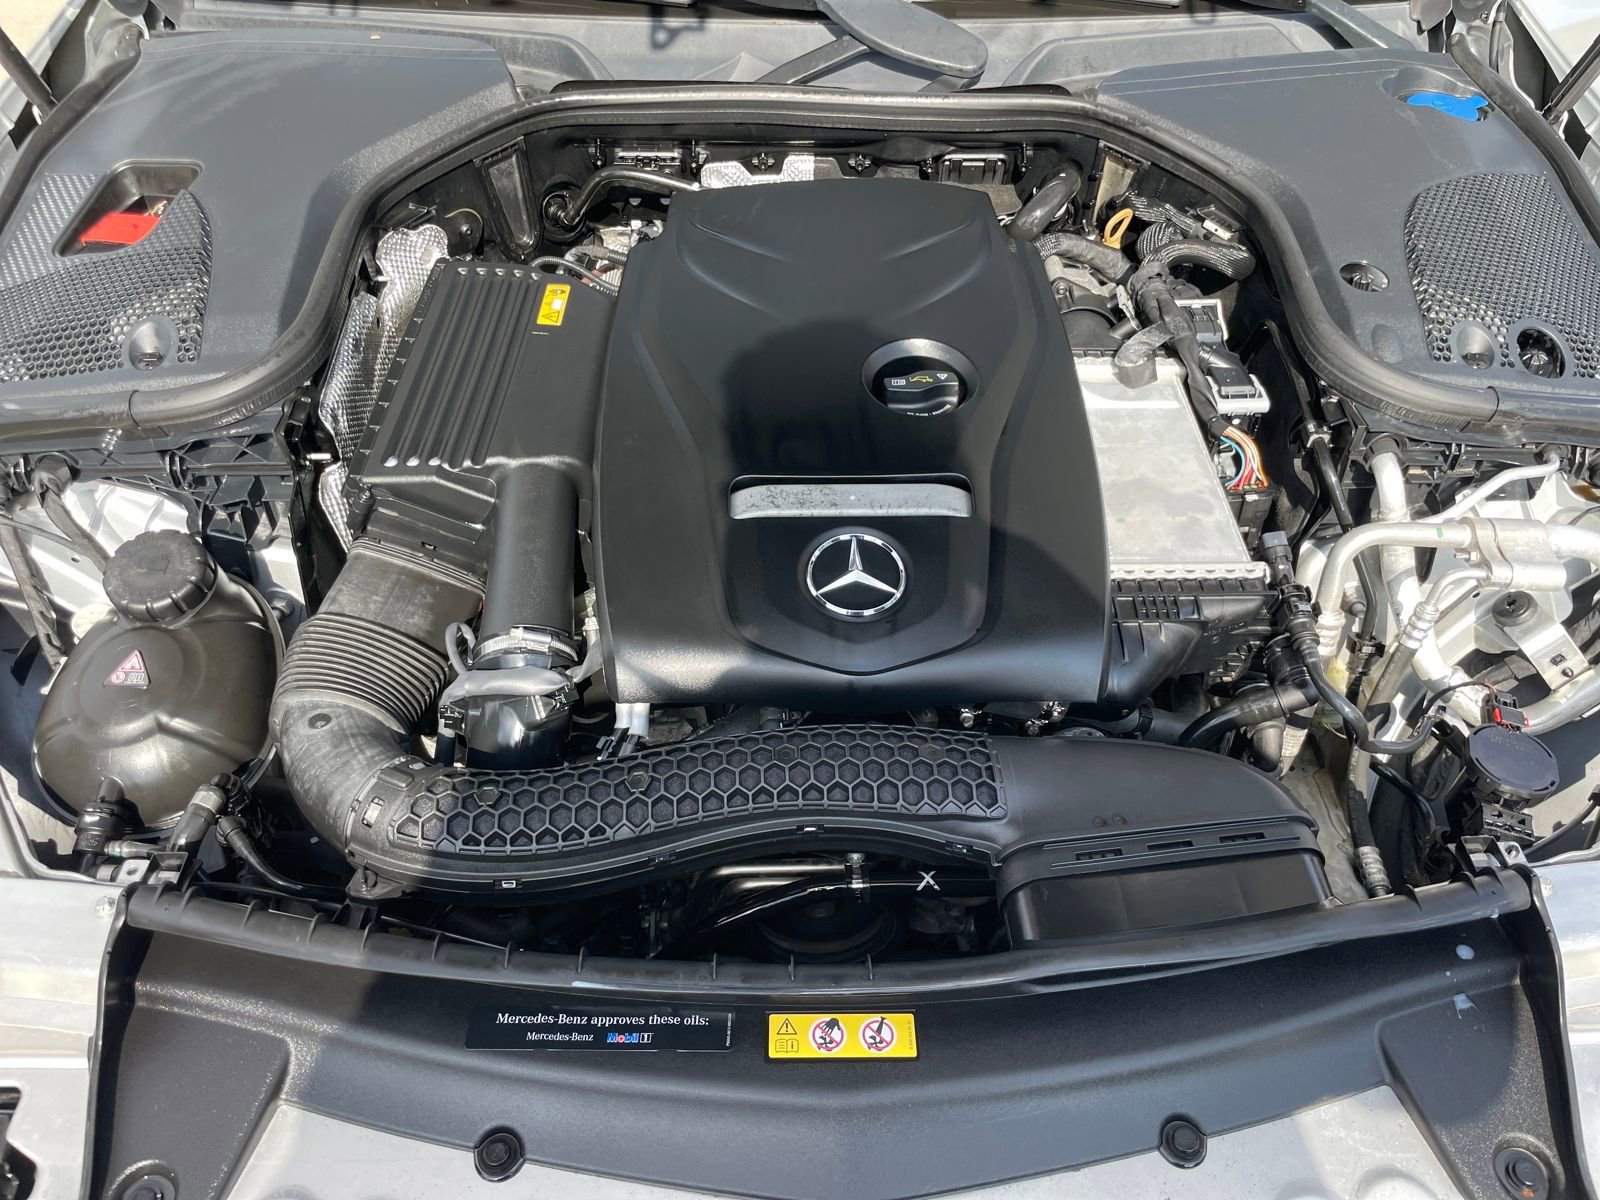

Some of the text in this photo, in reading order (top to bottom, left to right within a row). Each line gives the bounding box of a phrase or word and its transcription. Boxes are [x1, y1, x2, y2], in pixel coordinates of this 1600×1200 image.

[495, 1012, 710, 1027] Mercedes-Benz approves these oils:
[525, 1031, 594, 1041] Mercedes-Benz
[606, 1032, 640, 1043] Mobil
